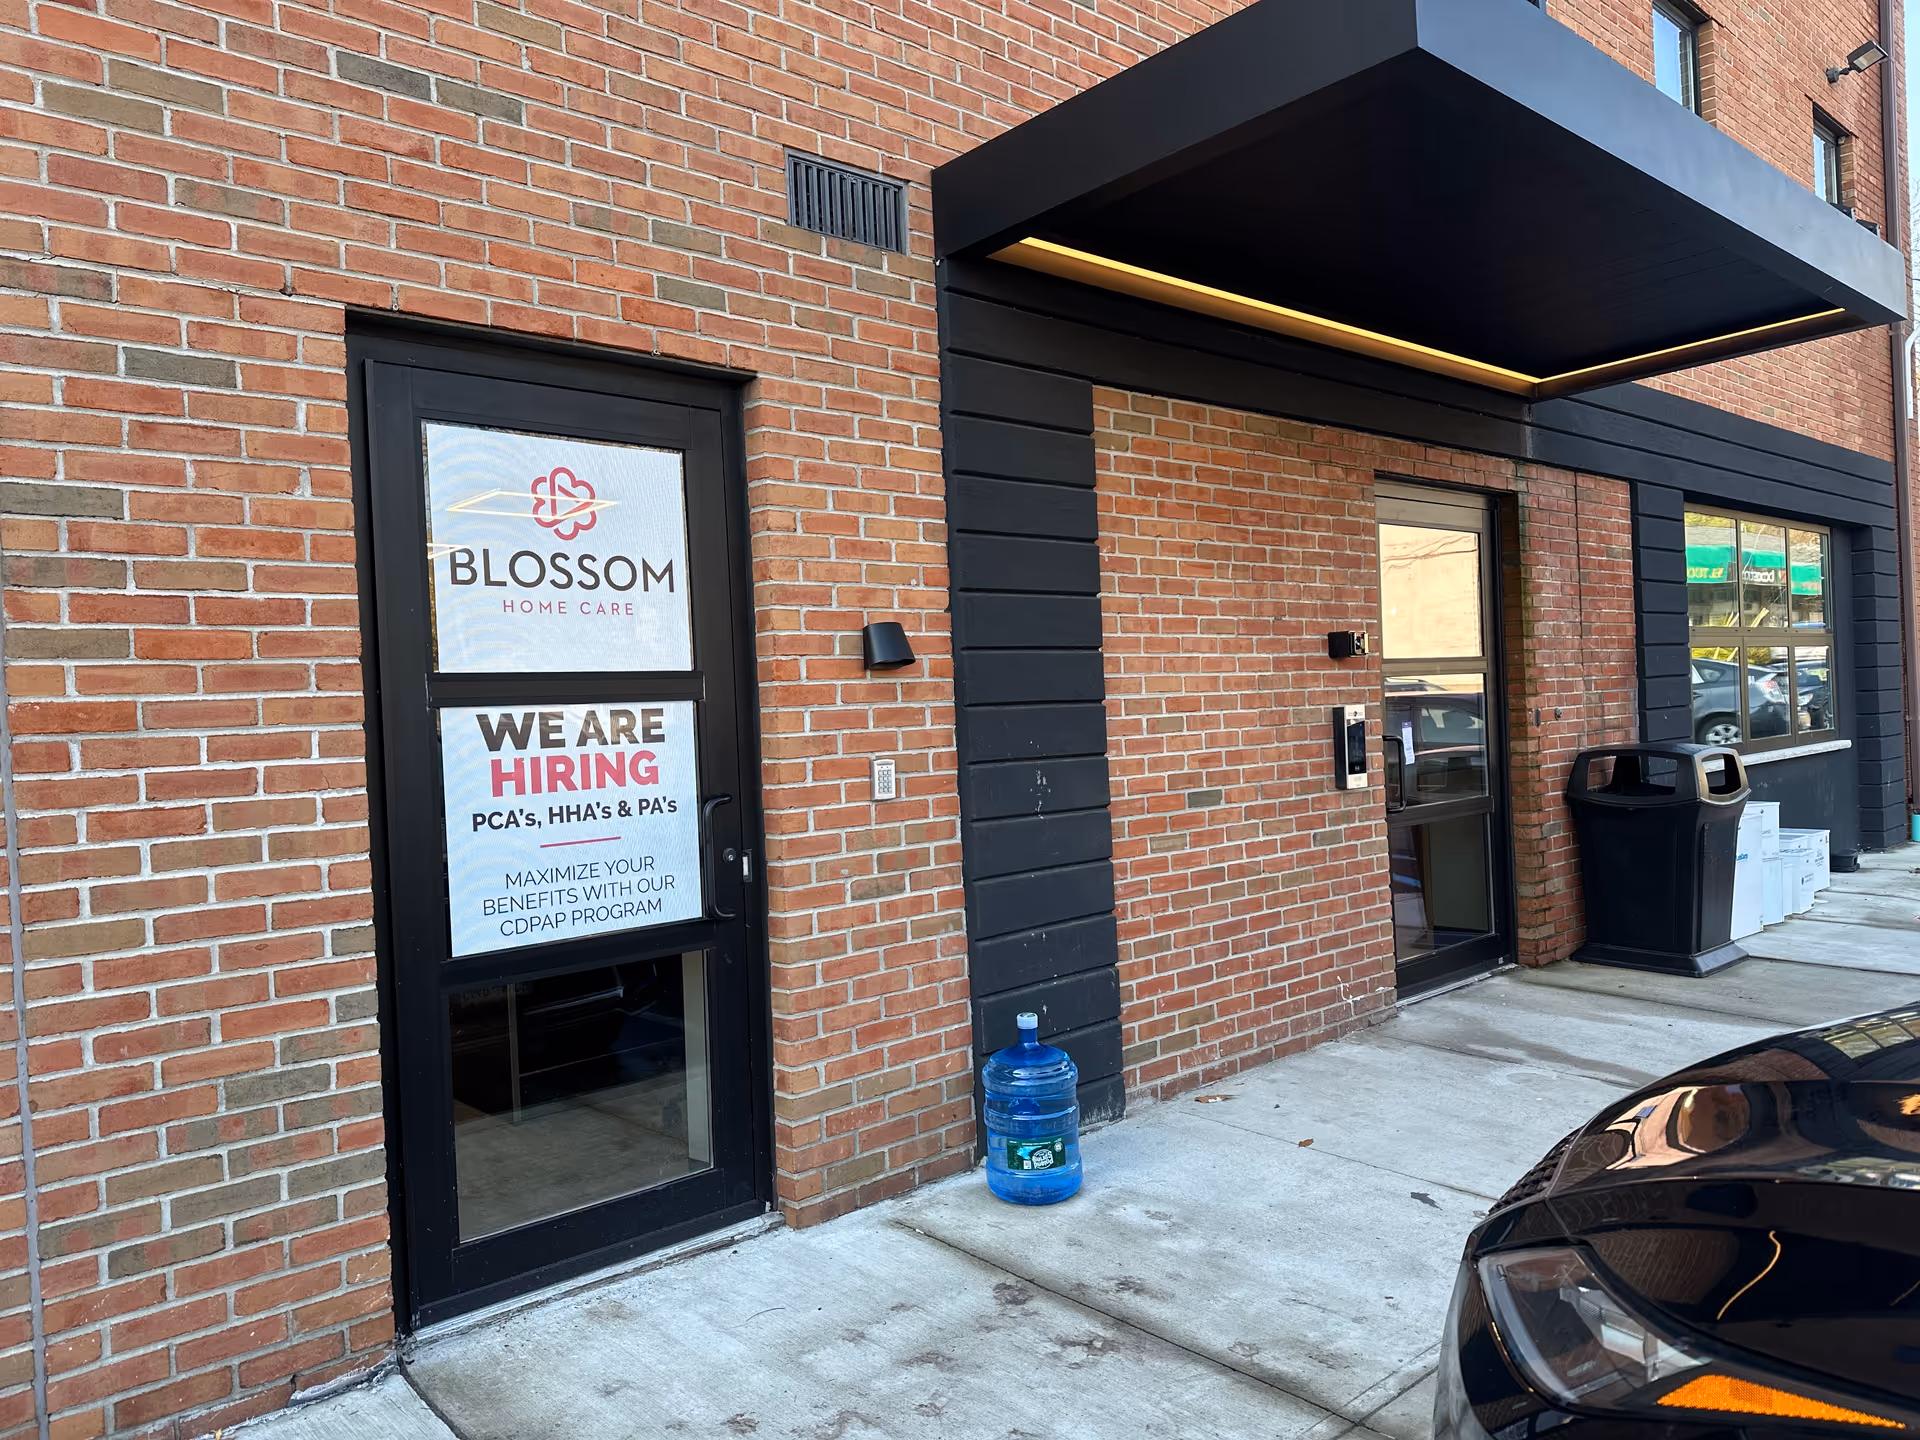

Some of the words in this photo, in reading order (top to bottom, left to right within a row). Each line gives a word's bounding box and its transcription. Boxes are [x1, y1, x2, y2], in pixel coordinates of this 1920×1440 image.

[451, 547, 675, 593] BLOSSOM
[503, 599, 567, 614] HOME
[580, 601, 634, 616] CARE
[476, 711, 566, 752] WE
[576, 708, 666, 747] ARE
[490, 750, 659, 798] HIRING
[472, 808, 542, 832] PCA's,
[548, 801, 612, 825] HHA's
[617, 800, 633, 818] &
[638, 796, 678, 816] PA's
[505, 861, 601, 890] MAXIMIZE
[604, 856, 655, 876] YOUR
[483, 887, 579, 916] BENEFITS
[582, 880, 632, 901] WITH
[637, 874, 676, 894] OUR
[500, 912, 567, 937] CDPAP
[572, 897, 663, 926] PROGRAM
